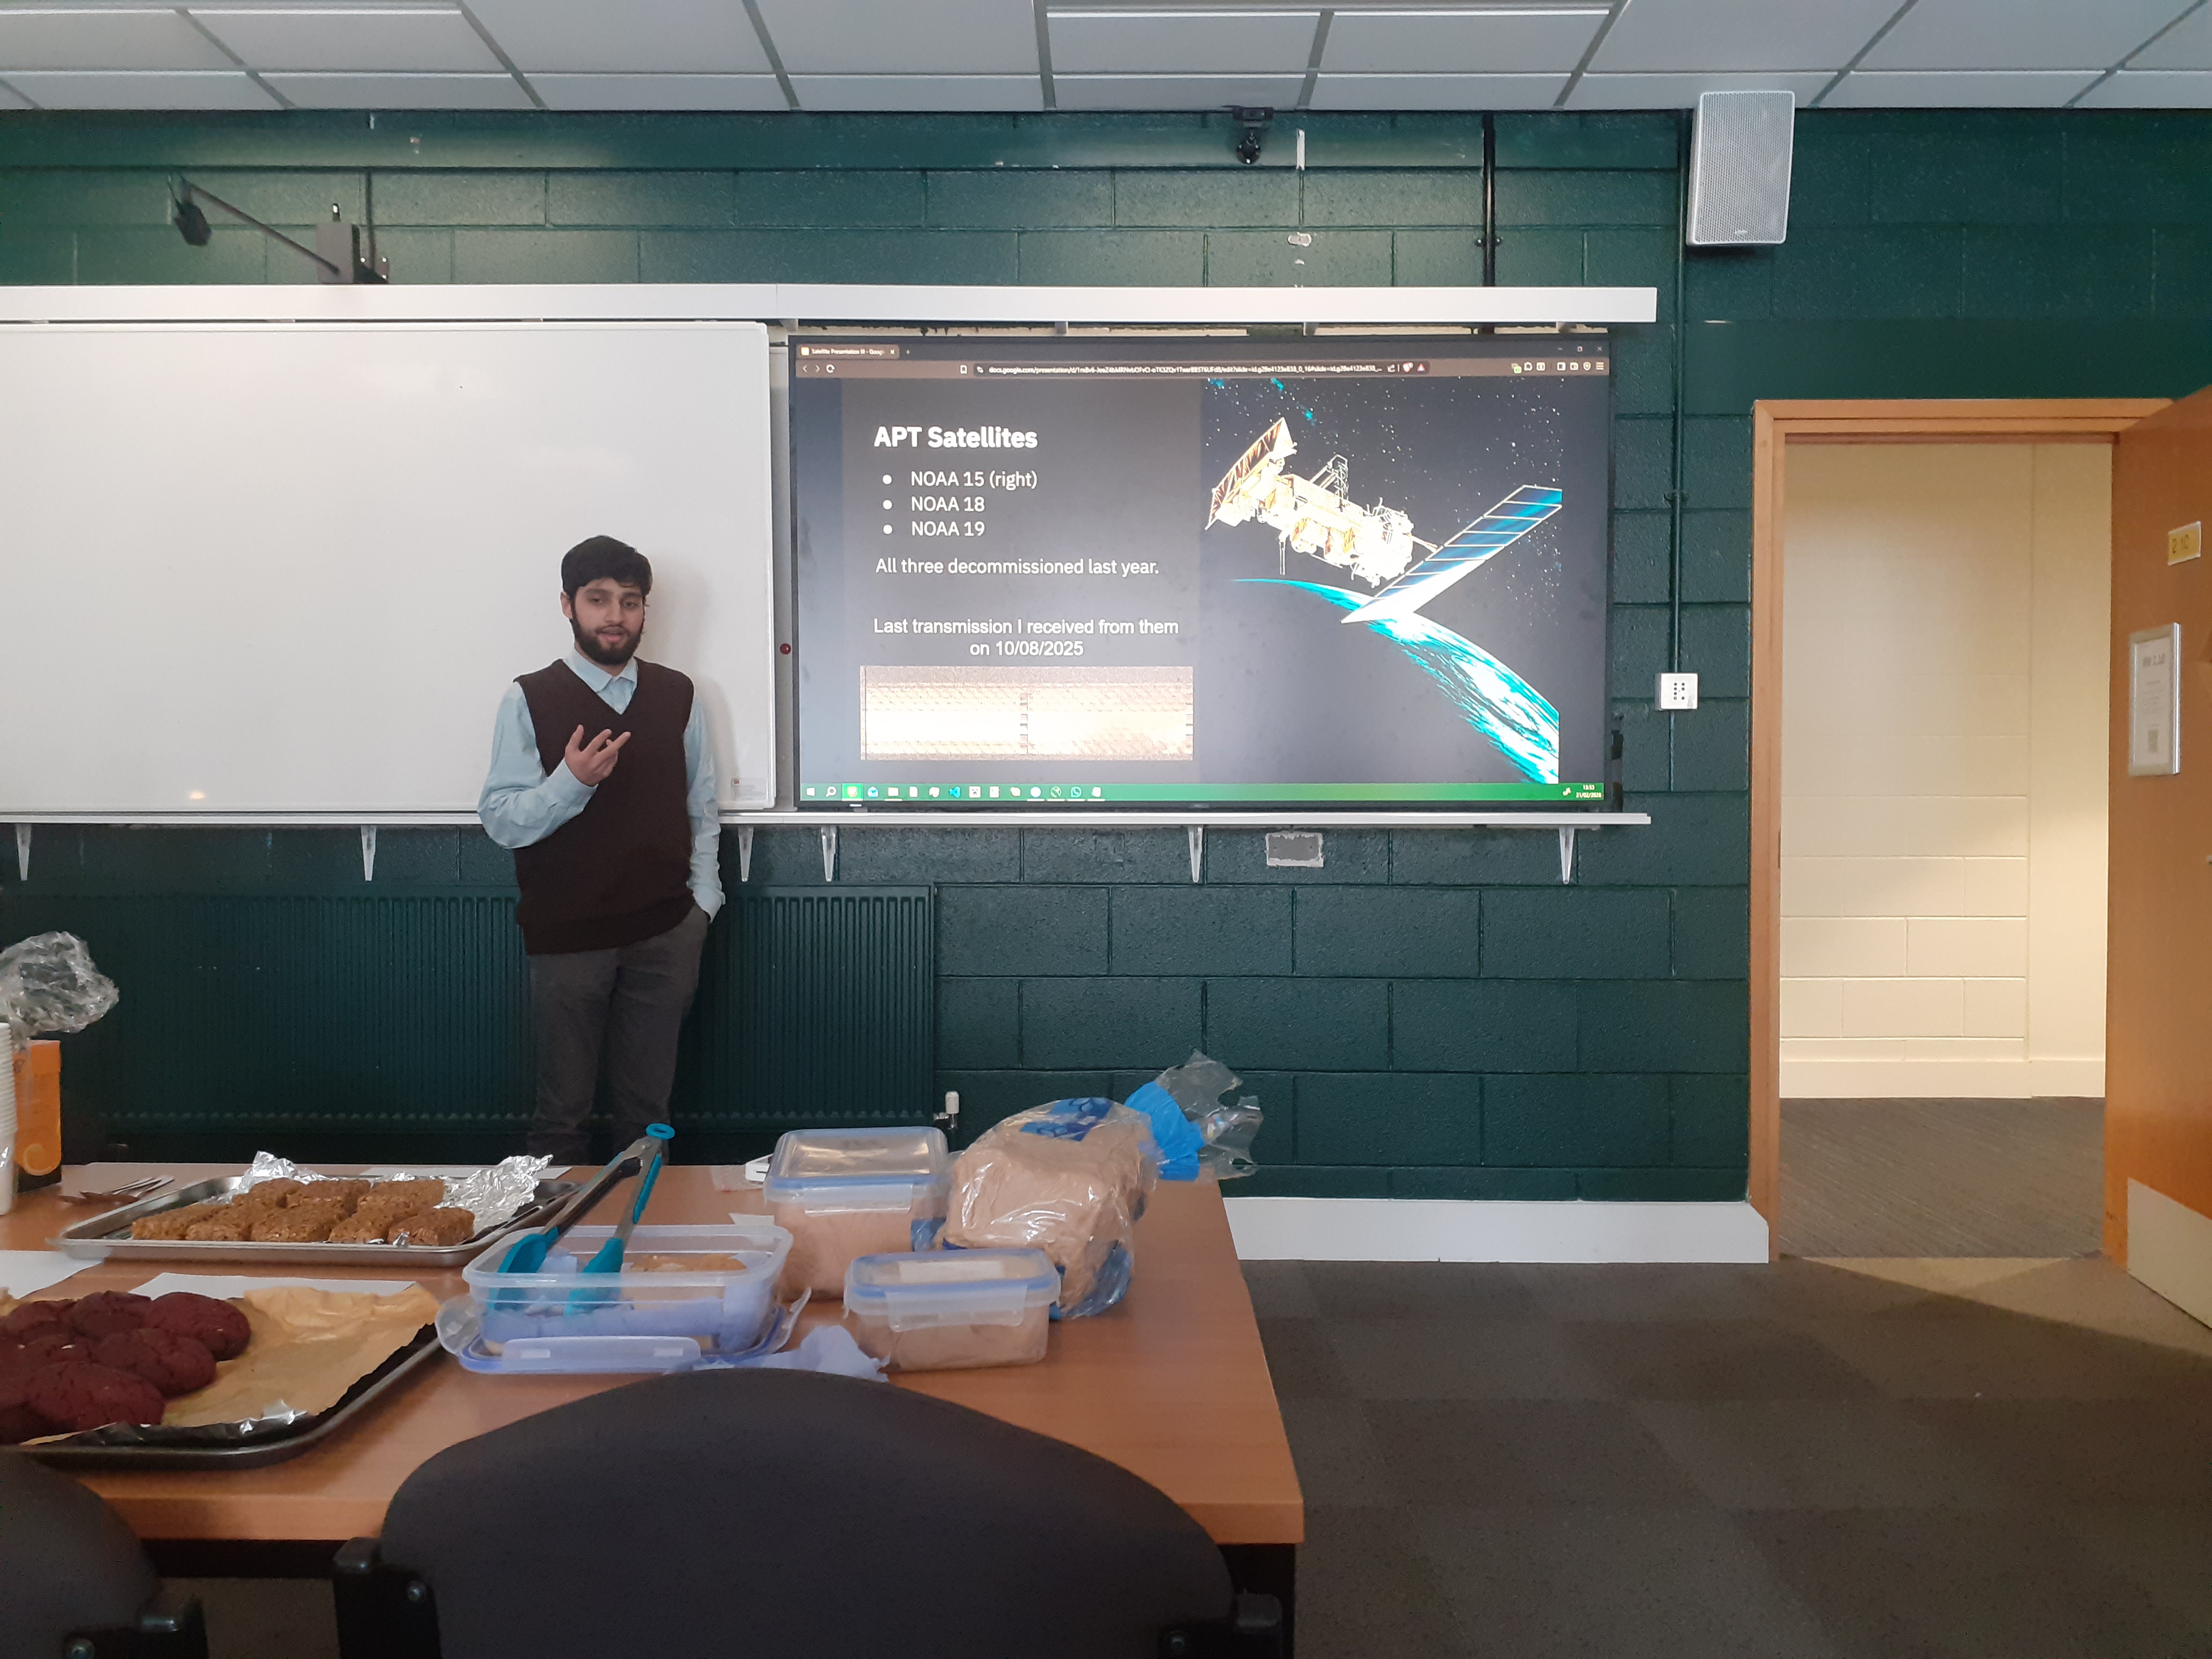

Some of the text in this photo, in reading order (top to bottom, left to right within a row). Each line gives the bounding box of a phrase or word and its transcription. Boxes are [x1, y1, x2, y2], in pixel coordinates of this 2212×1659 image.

[873, 426, 1038, 449] APT Satellites
[911, 470, 1037, 491] NOAA 15 (right)
[911, 496, 985, 512] NOAA 18
[911, 521, 985, 536] NOAA 19
[876, 557, 1160, 578] All three decommissioned last year.
[874, 618, 1179, 634] Last transmission I received from them
[970, 640, 1083, 656] on 10/08/2025
